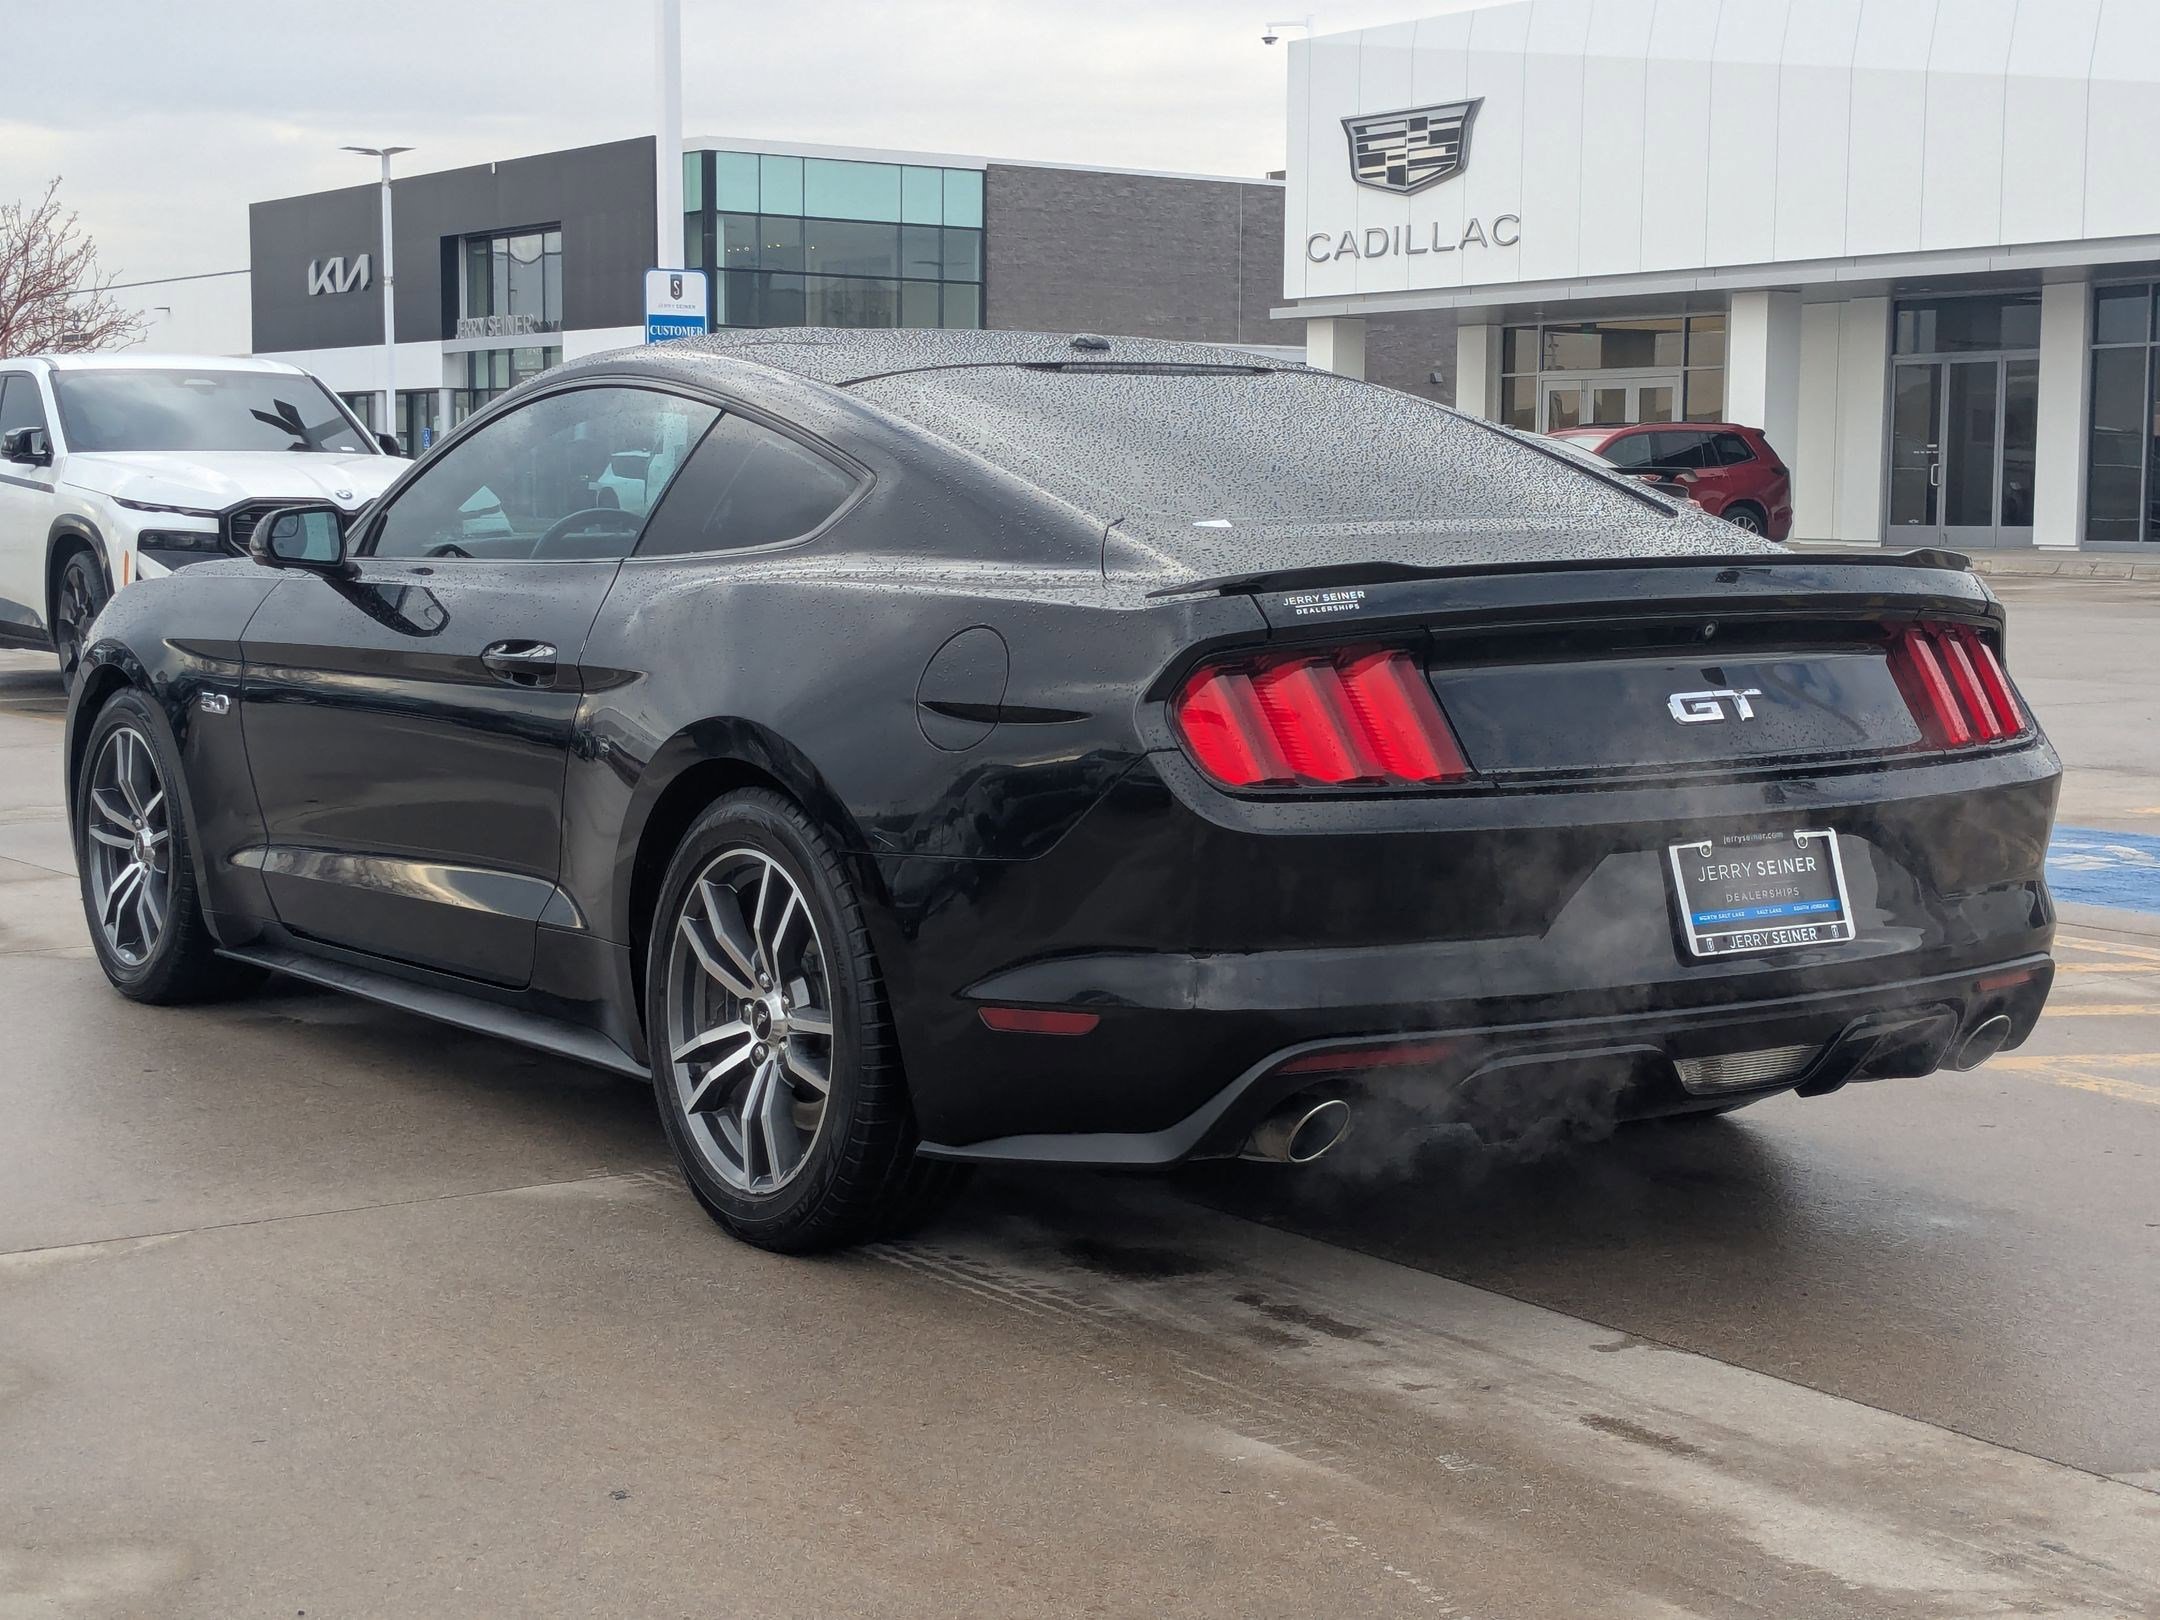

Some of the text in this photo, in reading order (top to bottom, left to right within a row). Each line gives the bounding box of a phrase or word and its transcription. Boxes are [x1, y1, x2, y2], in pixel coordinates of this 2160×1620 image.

[1306, 213, 1520, 263] CADILLAC
[308, 253, 370, 296] KIA
[456, 313, 535, 339] JERRY SEINER
[649, 324, 704, 337] CUSTOMER
[1283, 590, 1366, 606] JERRY SEINER
[1296, 603, 1360, 615] DEALERSHIPS
[1667, 688, 1763, 726] GT
[1697, 856, 1817, 882] JERRY SEINER
[1725, 886, 1800, 903] DEALERSHIPS
[1730, 931, 1771, 949] JERRY
[1772, 927, 1818, 945] SEINER
